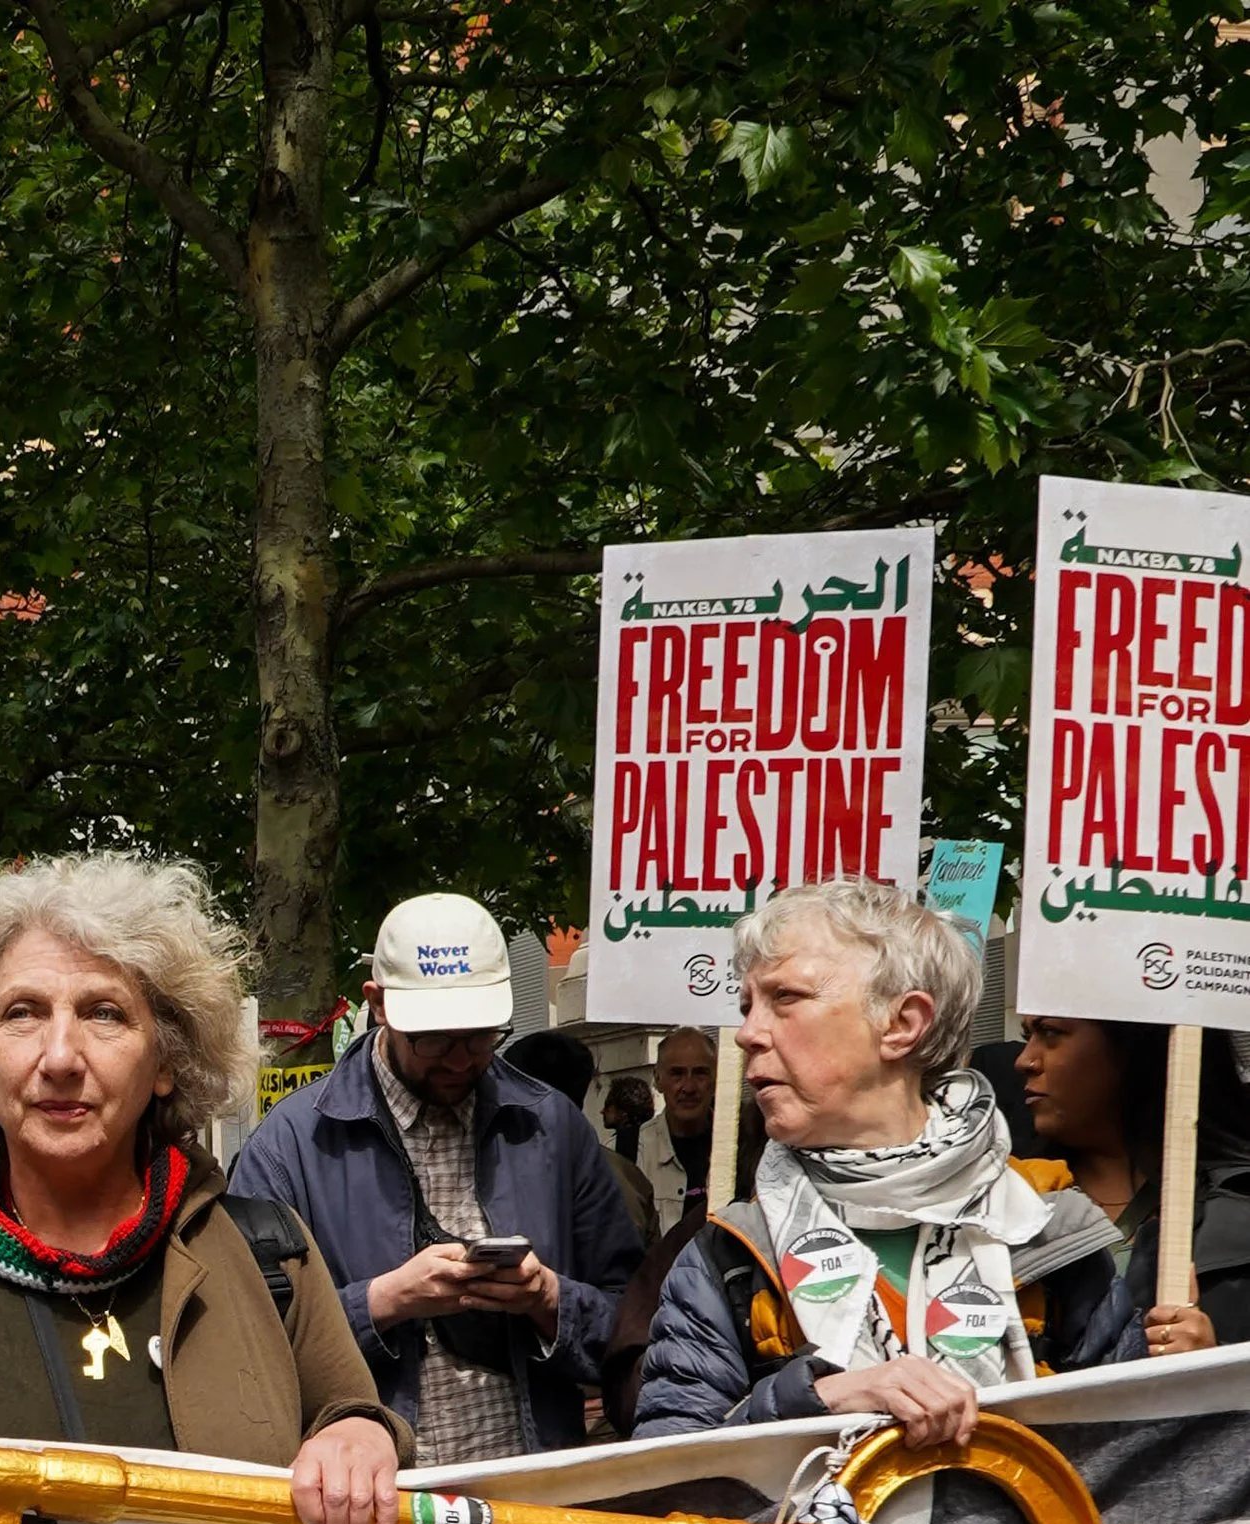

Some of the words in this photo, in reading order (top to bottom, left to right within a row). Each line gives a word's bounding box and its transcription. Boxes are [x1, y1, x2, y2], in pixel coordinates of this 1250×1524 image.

[1097, 549, 1183, 571] NAKBA
[1189, 556, 1216, 573] 78
[620, 554, 911, 634] الحرية
[652, 601, 724, 617] NAKBA
[731, 600, 757, 614] 78
[615, 617, 907, 754] FREEDOM
[1138, 692, 1211, 724] FOR
[686, 729, 751, 753] FOR
[610, 757, 901, 892] PALESTINE
[417, 945, 469, 960] Never
[1186, 950, 1250, 966] PALESTIN
[418, 960, 473, 977] Work
[821, 1256, 842, 1272] FOA
[966, 1314, 987, 1328] FOA
